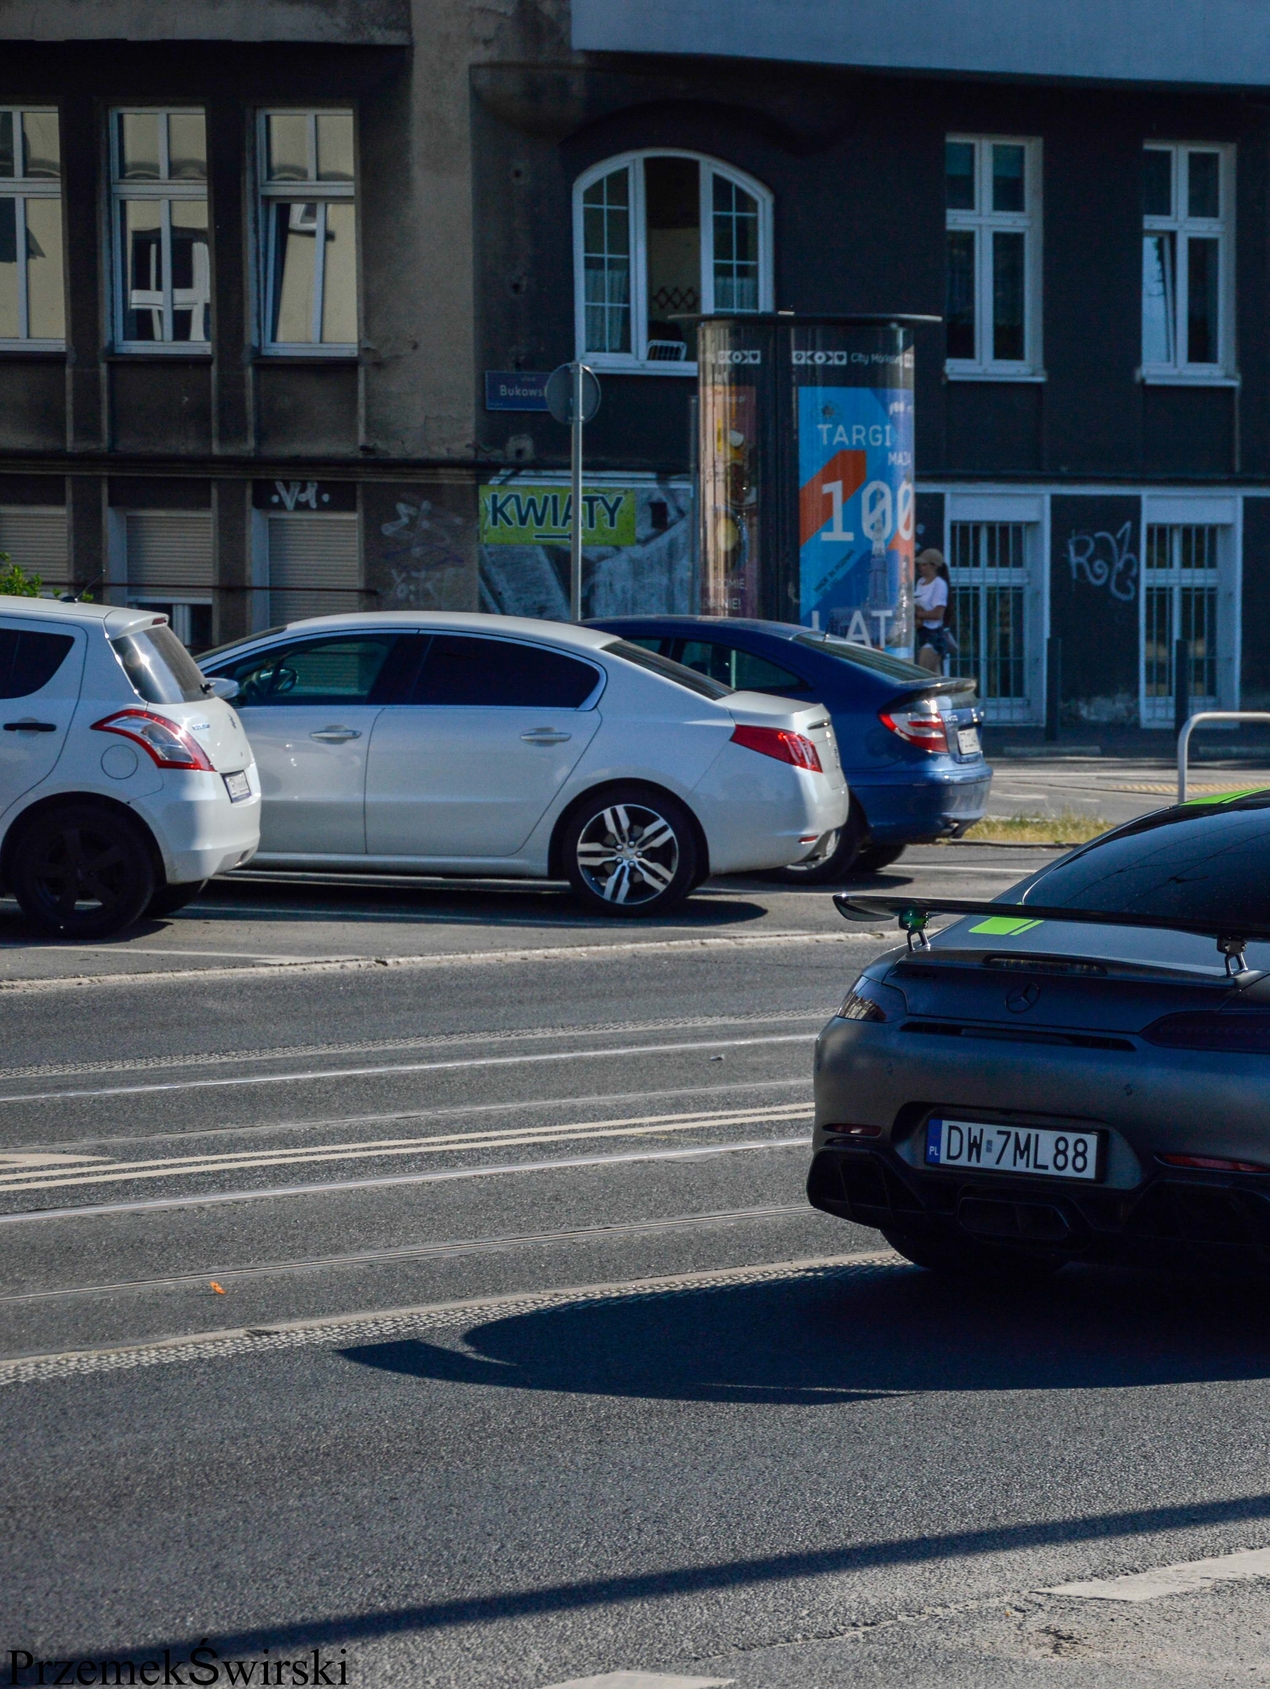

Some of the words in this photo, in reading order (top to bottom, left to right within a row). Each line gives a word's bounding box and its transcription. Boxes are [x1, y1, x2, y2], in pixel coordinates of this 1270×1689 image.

[499, 385, 547, 397] Bukows
[817, 423, 891, 448] TARGI
[821, 480, 914, 542] 100
[929, 1147, 939, 1156] PL
[946, 1125, 984, 1163] DW
[995, 1130, 1088, 1173] 7ML88
